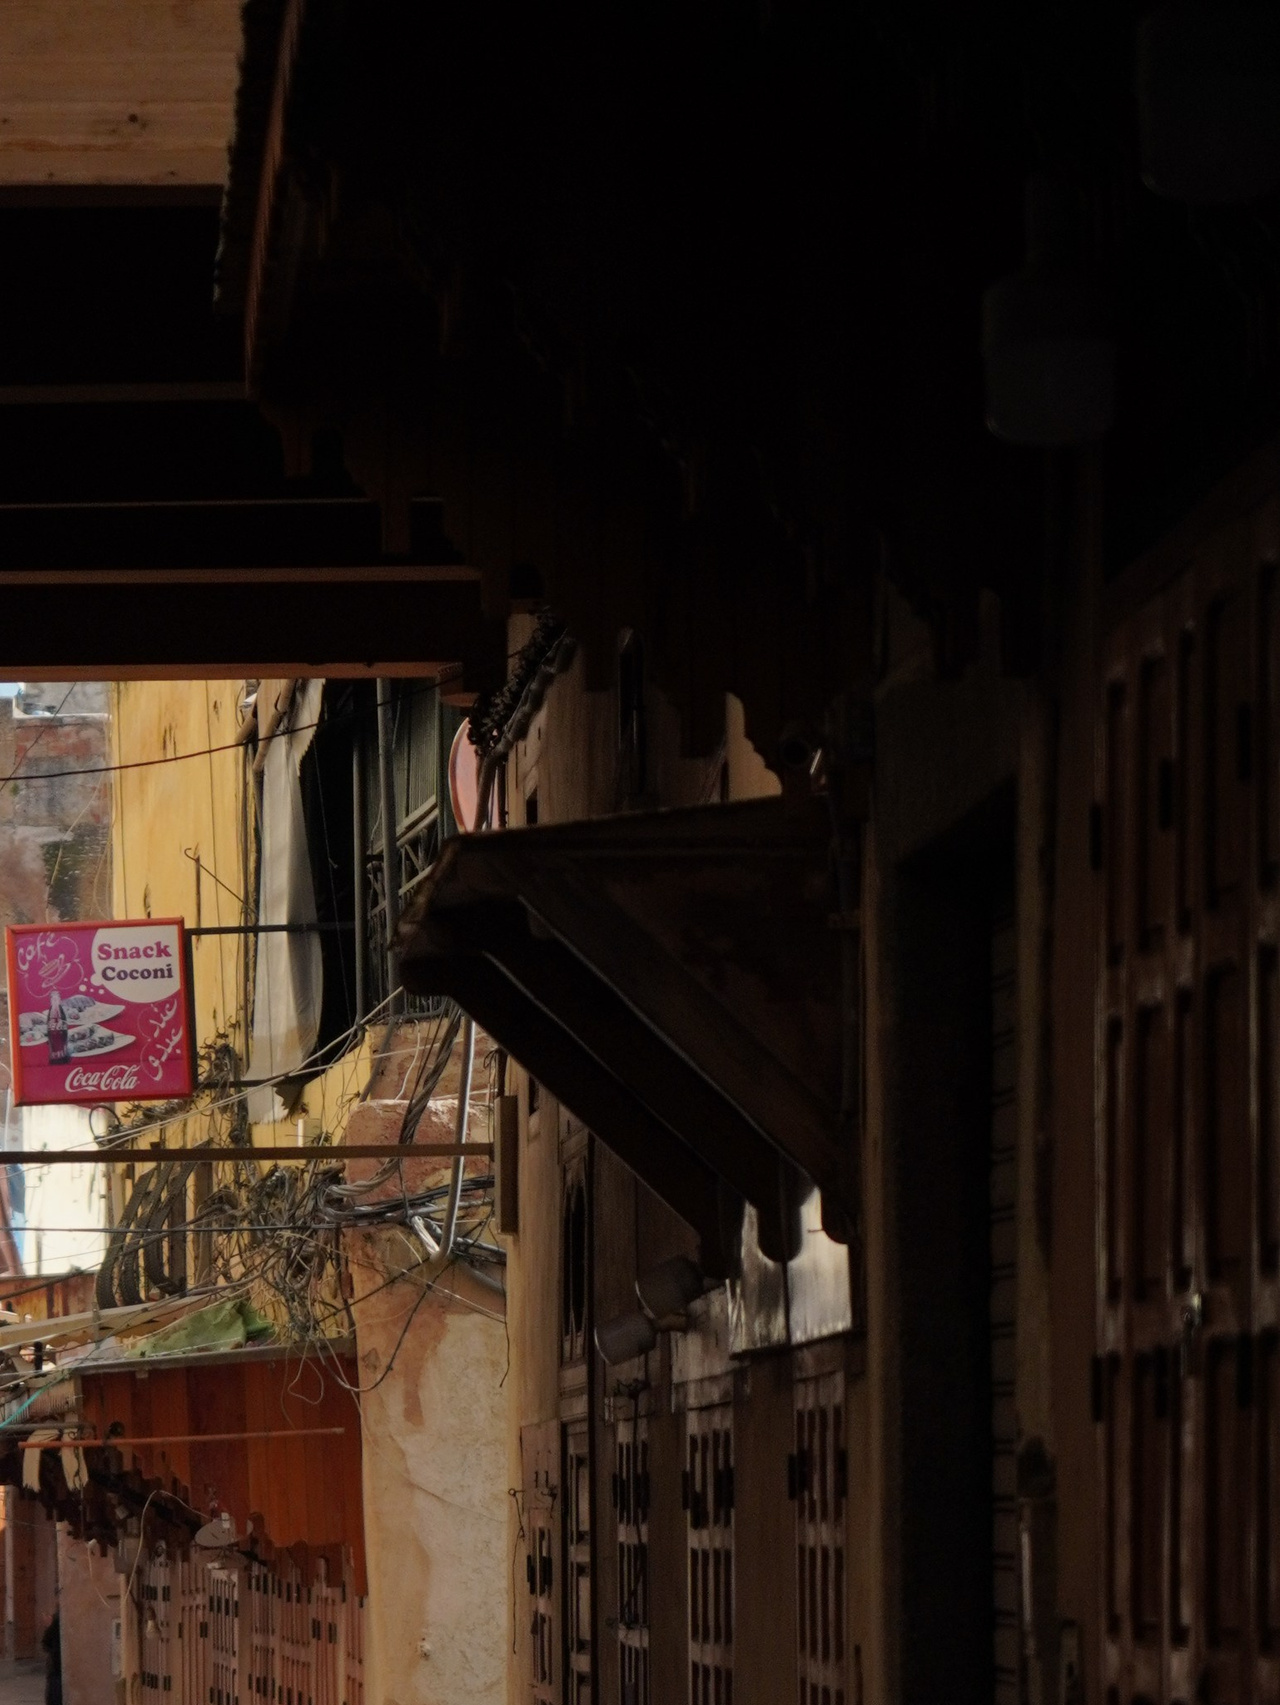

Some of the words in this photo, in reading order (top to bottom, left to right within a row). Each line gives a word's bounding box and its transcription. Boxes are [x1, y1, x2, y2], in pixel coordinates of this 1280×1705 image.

[97, 941, 172, 961] Snack
[101, 963, 174, 981] Coconi
[64, 1064, 141, 1092] Coca-Cola
